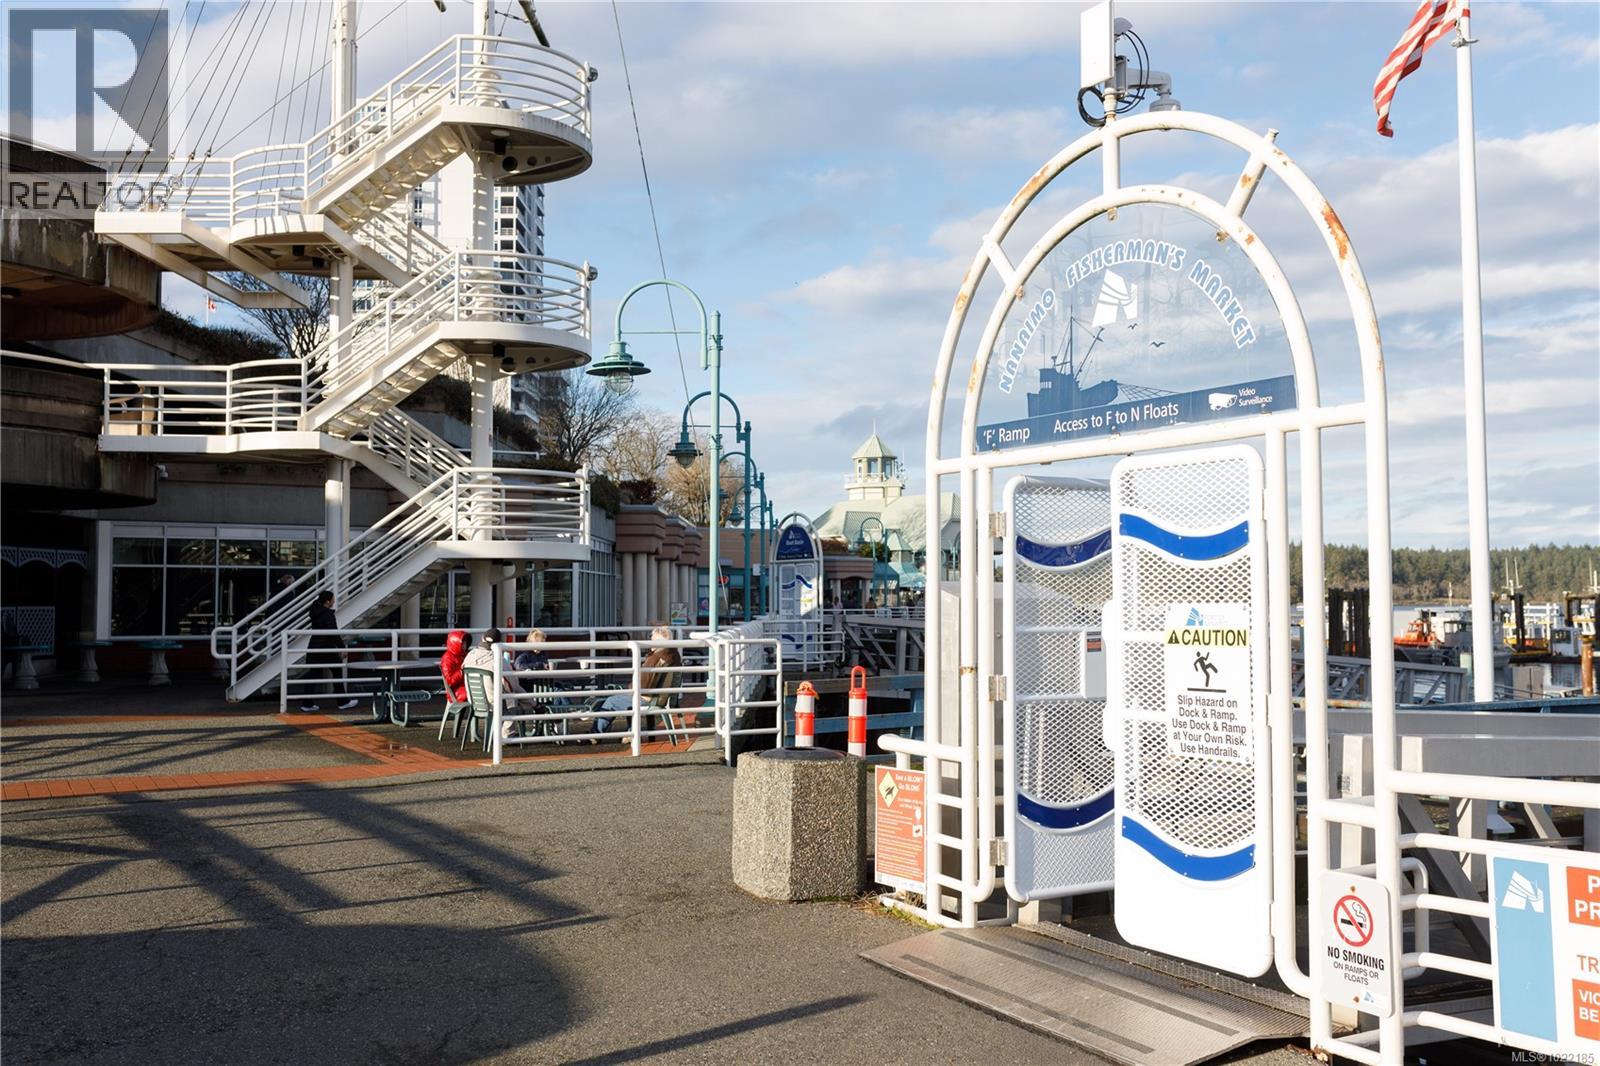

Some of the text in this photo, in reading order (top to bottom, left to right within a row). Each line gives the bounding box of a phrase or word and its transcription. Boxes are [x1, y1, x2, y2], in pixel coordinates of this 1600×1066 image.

[999, 238, 1257, 395] NANAIMO FISHERMAN'S MARKET
[1239, 387, 1256, 397] Video
[1239, 395, 1272, 407] Surveillance
[1054, 402, 1179, 434] Access to F to N Floats
[999, 427, 1030, 443] Ramp
[1181, 629, 1247, 646] CAUTION
[1177, 694, 1238, 708] Slip Hazard on
[1179, 706, 1238, 722] Dock & Ramp.
[1172, 717, 1247, 736] Use Dock & Ramp
[1173, 730, 1247, 747] at Your Own Risk.
[1180, 742, 1241, 758] Use Handrails.
[1327, 945, 1385, 971] NO SMOKING
[1333, 961, 1379, 980] ON RAMPS OR
[1344, 972, 1369, 986] FLOATS
